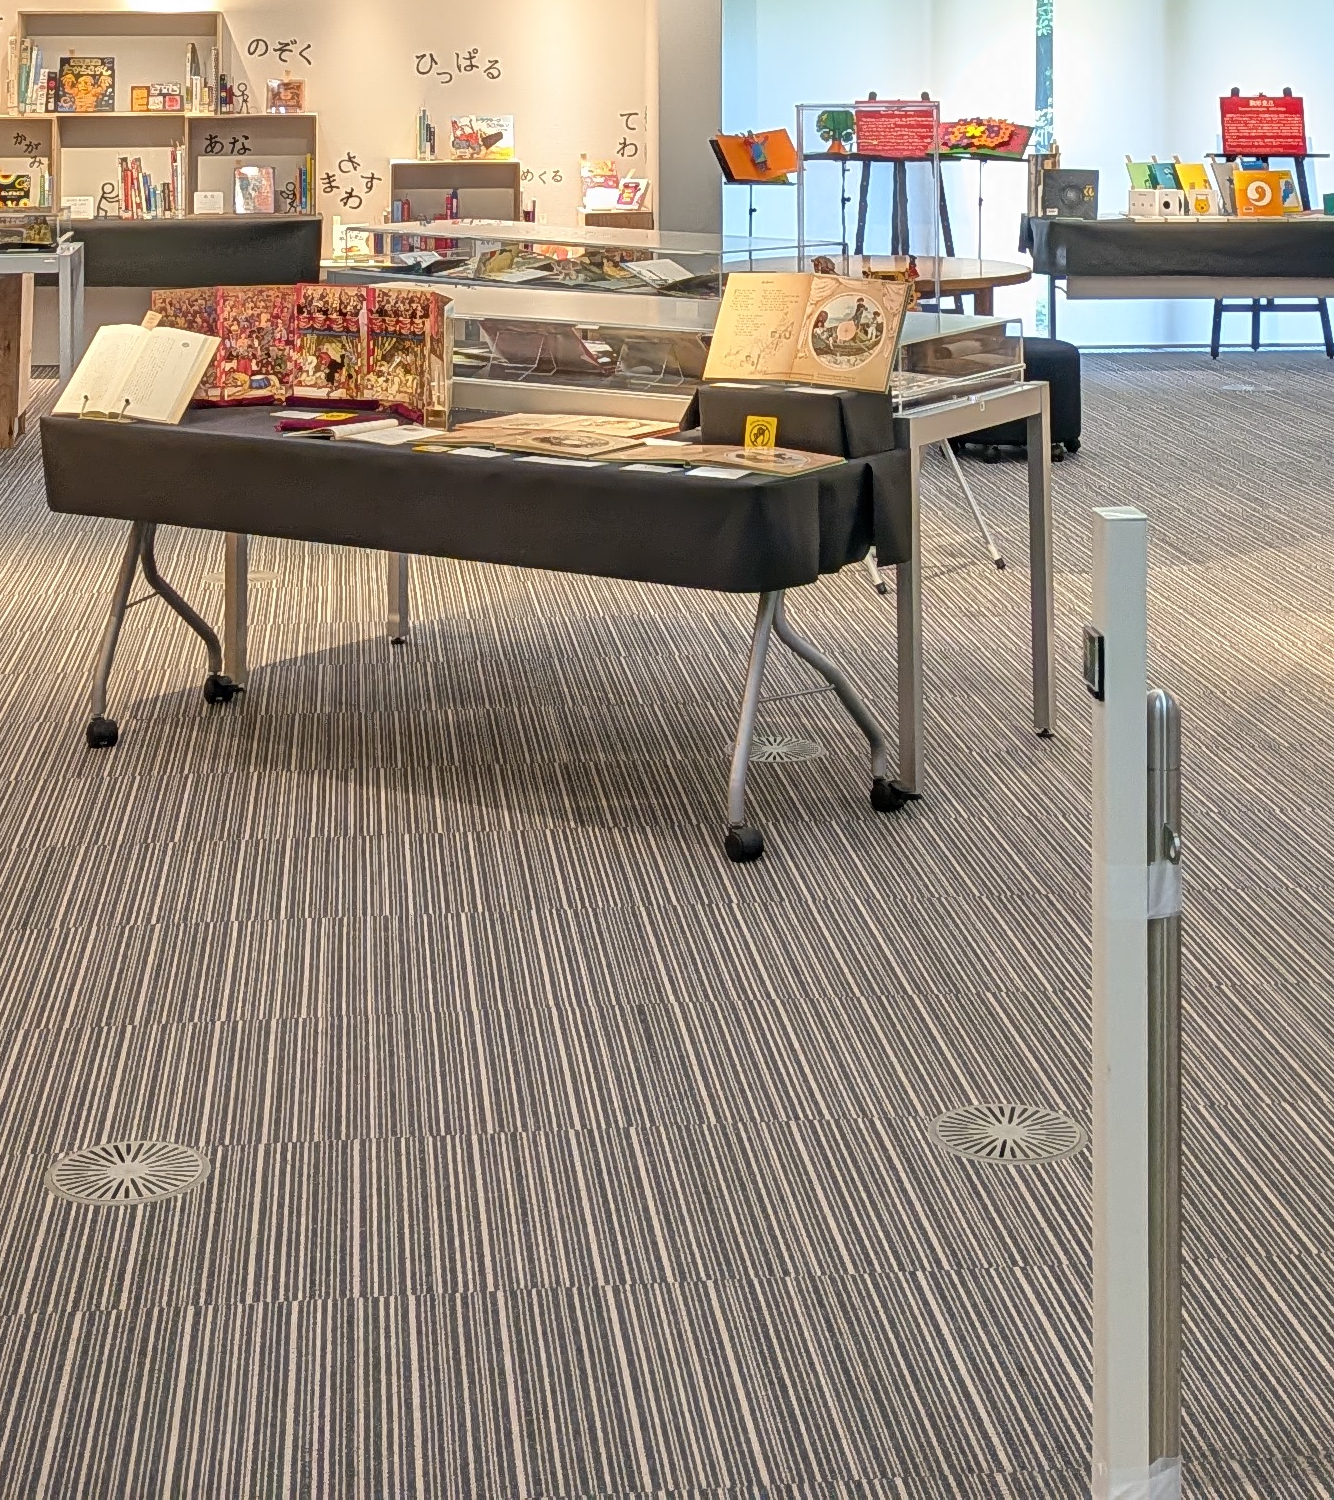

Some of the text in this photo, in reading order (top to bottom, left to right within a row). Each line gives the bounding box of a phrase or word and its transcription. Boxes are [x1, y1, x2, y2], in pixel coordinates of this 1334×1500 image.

[247, 38, 313, 66] のぞく
[415, 48, 503, 84] ひっぱる
[12, 132, 45, 169] かがみ
[204, 133, 252, 156] あな
[520, 168, 564, 184] めくる
